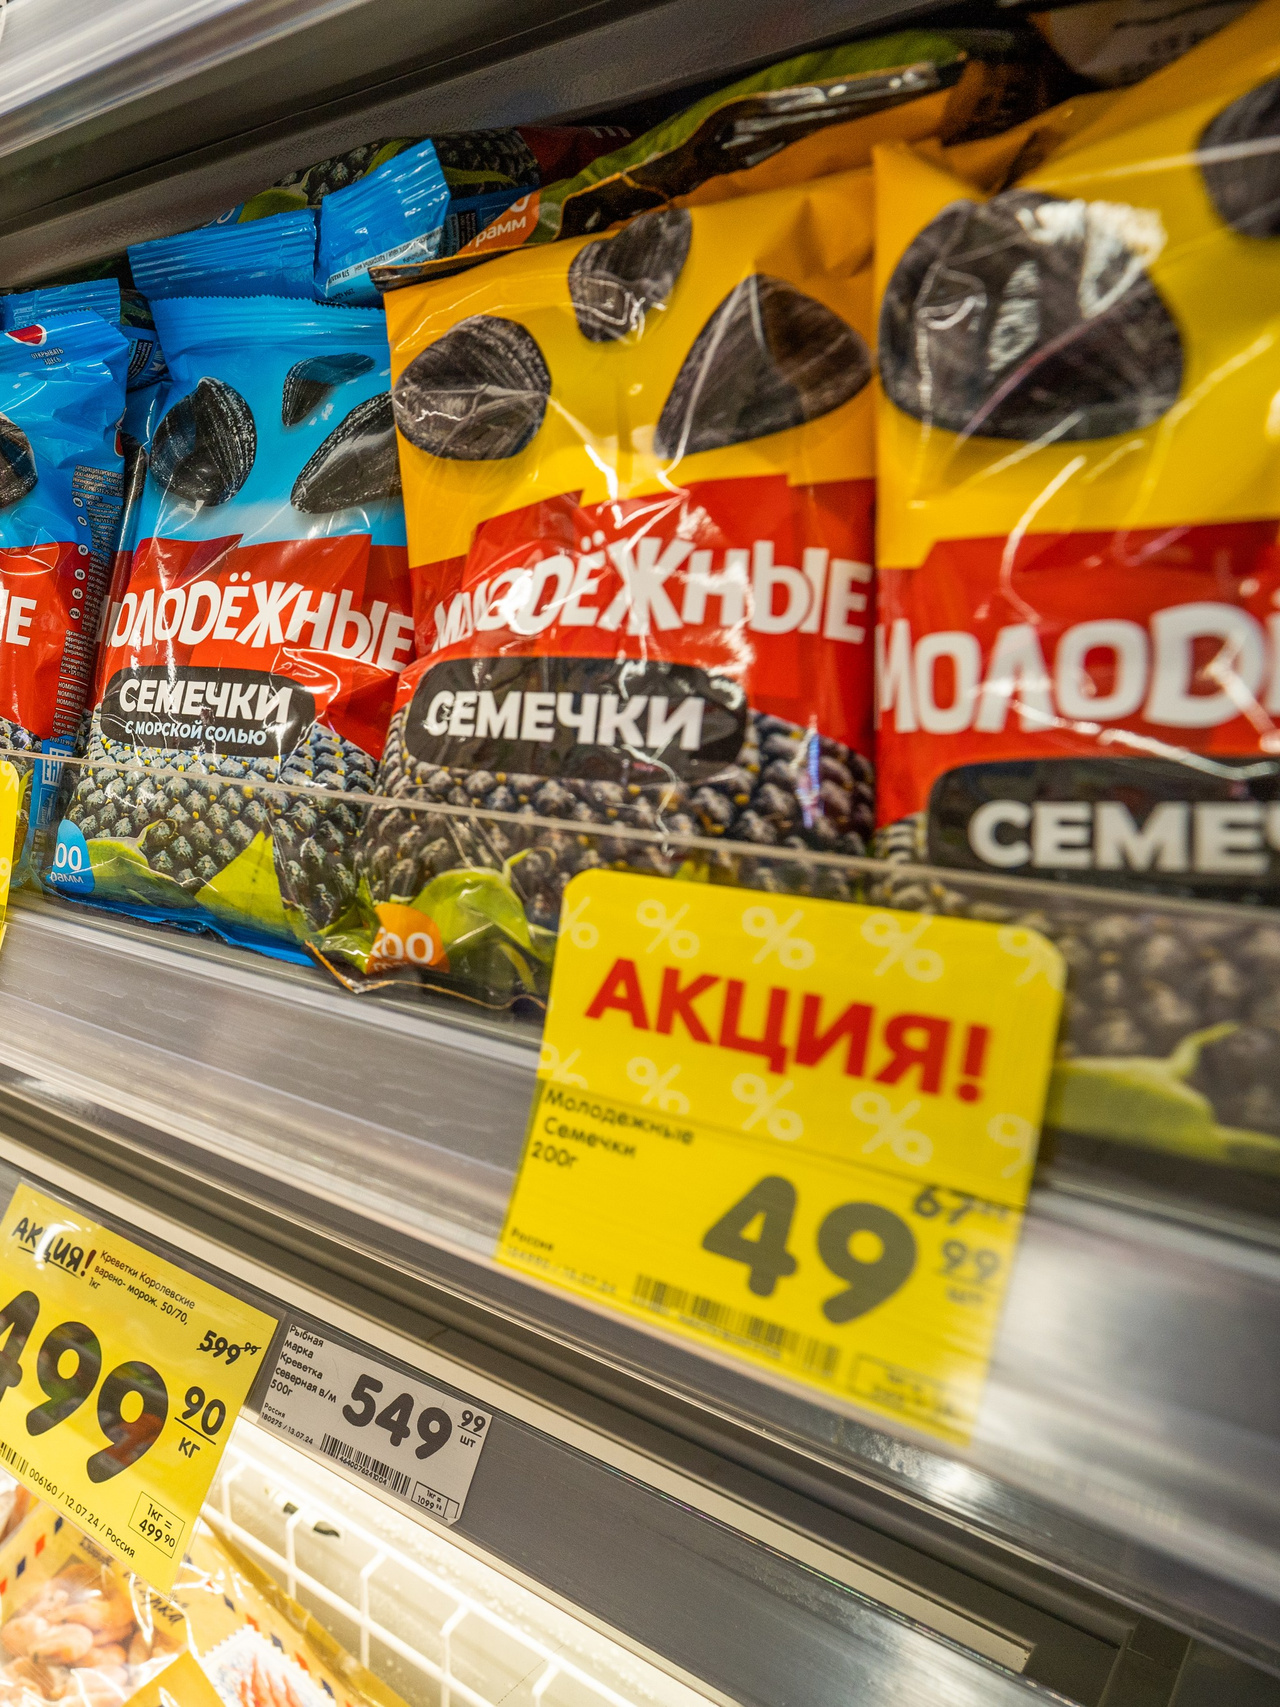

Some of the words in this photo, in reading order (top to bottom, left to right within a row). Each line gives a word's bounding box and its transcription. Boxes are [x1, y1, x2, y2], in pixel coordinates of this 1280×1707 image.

[470, 215, 527, 248] рамм
[875, 602, 1280, 734] МОЛОД
[119, 678, 294, 723] СЕМЕЧКИ
[134, 718, 204, 740] МОРСКОЙ
[204, 724, 267, 746] СОЛЬЮ
[425, 690, 705, 751] СЕМЕЧКИ
[968, 799, 1280, 874] СЕМЕ
[53, 842, 82, 871] 00
[50, 871, 84, 884] рамм
[584, 957, 993, 1106] АКЦИЯ!
[545, 1087, 695, 1147] Молодежные
[543, 1116, 637, 1158] Семечки
[531, 1140, 579, 1169] 200г
[11, 1217, 97, 1277] АКЦИЯ!
[701, 1174, 918, 1326] 49
[88, 1276, 101, 1290] 1кг
[94, 1266, 127, 1289] варено-
[126, 1284, 159, 1309] морож.
[160, 1301, 189, 1326] 50/70,
[99, 1249, 140, 1280] Креветки
[138, 1270, 196, 1310] Королевские
[198, 1329, 241, 1366] 599
[243, 1341, 259, 1356] 99
[284, 1339, 314, 1359] марка
[289, 1325, 324, 1348] Рыбная
[280, 1352, 324, 1380] Креветка
[270, 1379, 294, 1398] 500г
[275, 1366, 318, 1394] северная
[318, 1385, 338, 1404] в/м
[181, 1385, 227, 1437] 90
[264, 1402, 286, 1419] Россия
[342, 1373, 453, 1461] 549
[460, 1409, 487, 1433] 99
[261, 1411, 284, 1430] 180275
[287, 1425, 314, 1446] 13.07.24
[459, 1435, 477, 1449] шт
[416, 1495, 435, 1511] 1099
[426, 1489, 437, 1501] 1кг
[29, 1467, 58, 1496] 006160
[65, 1494, 100, 1528] 12.07.24
[105, 1528, 137, 1559] Россия
[147, 1503, 164, 1522] 1кг
[138, 1518, 163, 1542] 499
[164, 1534, 176, 1549] 90
